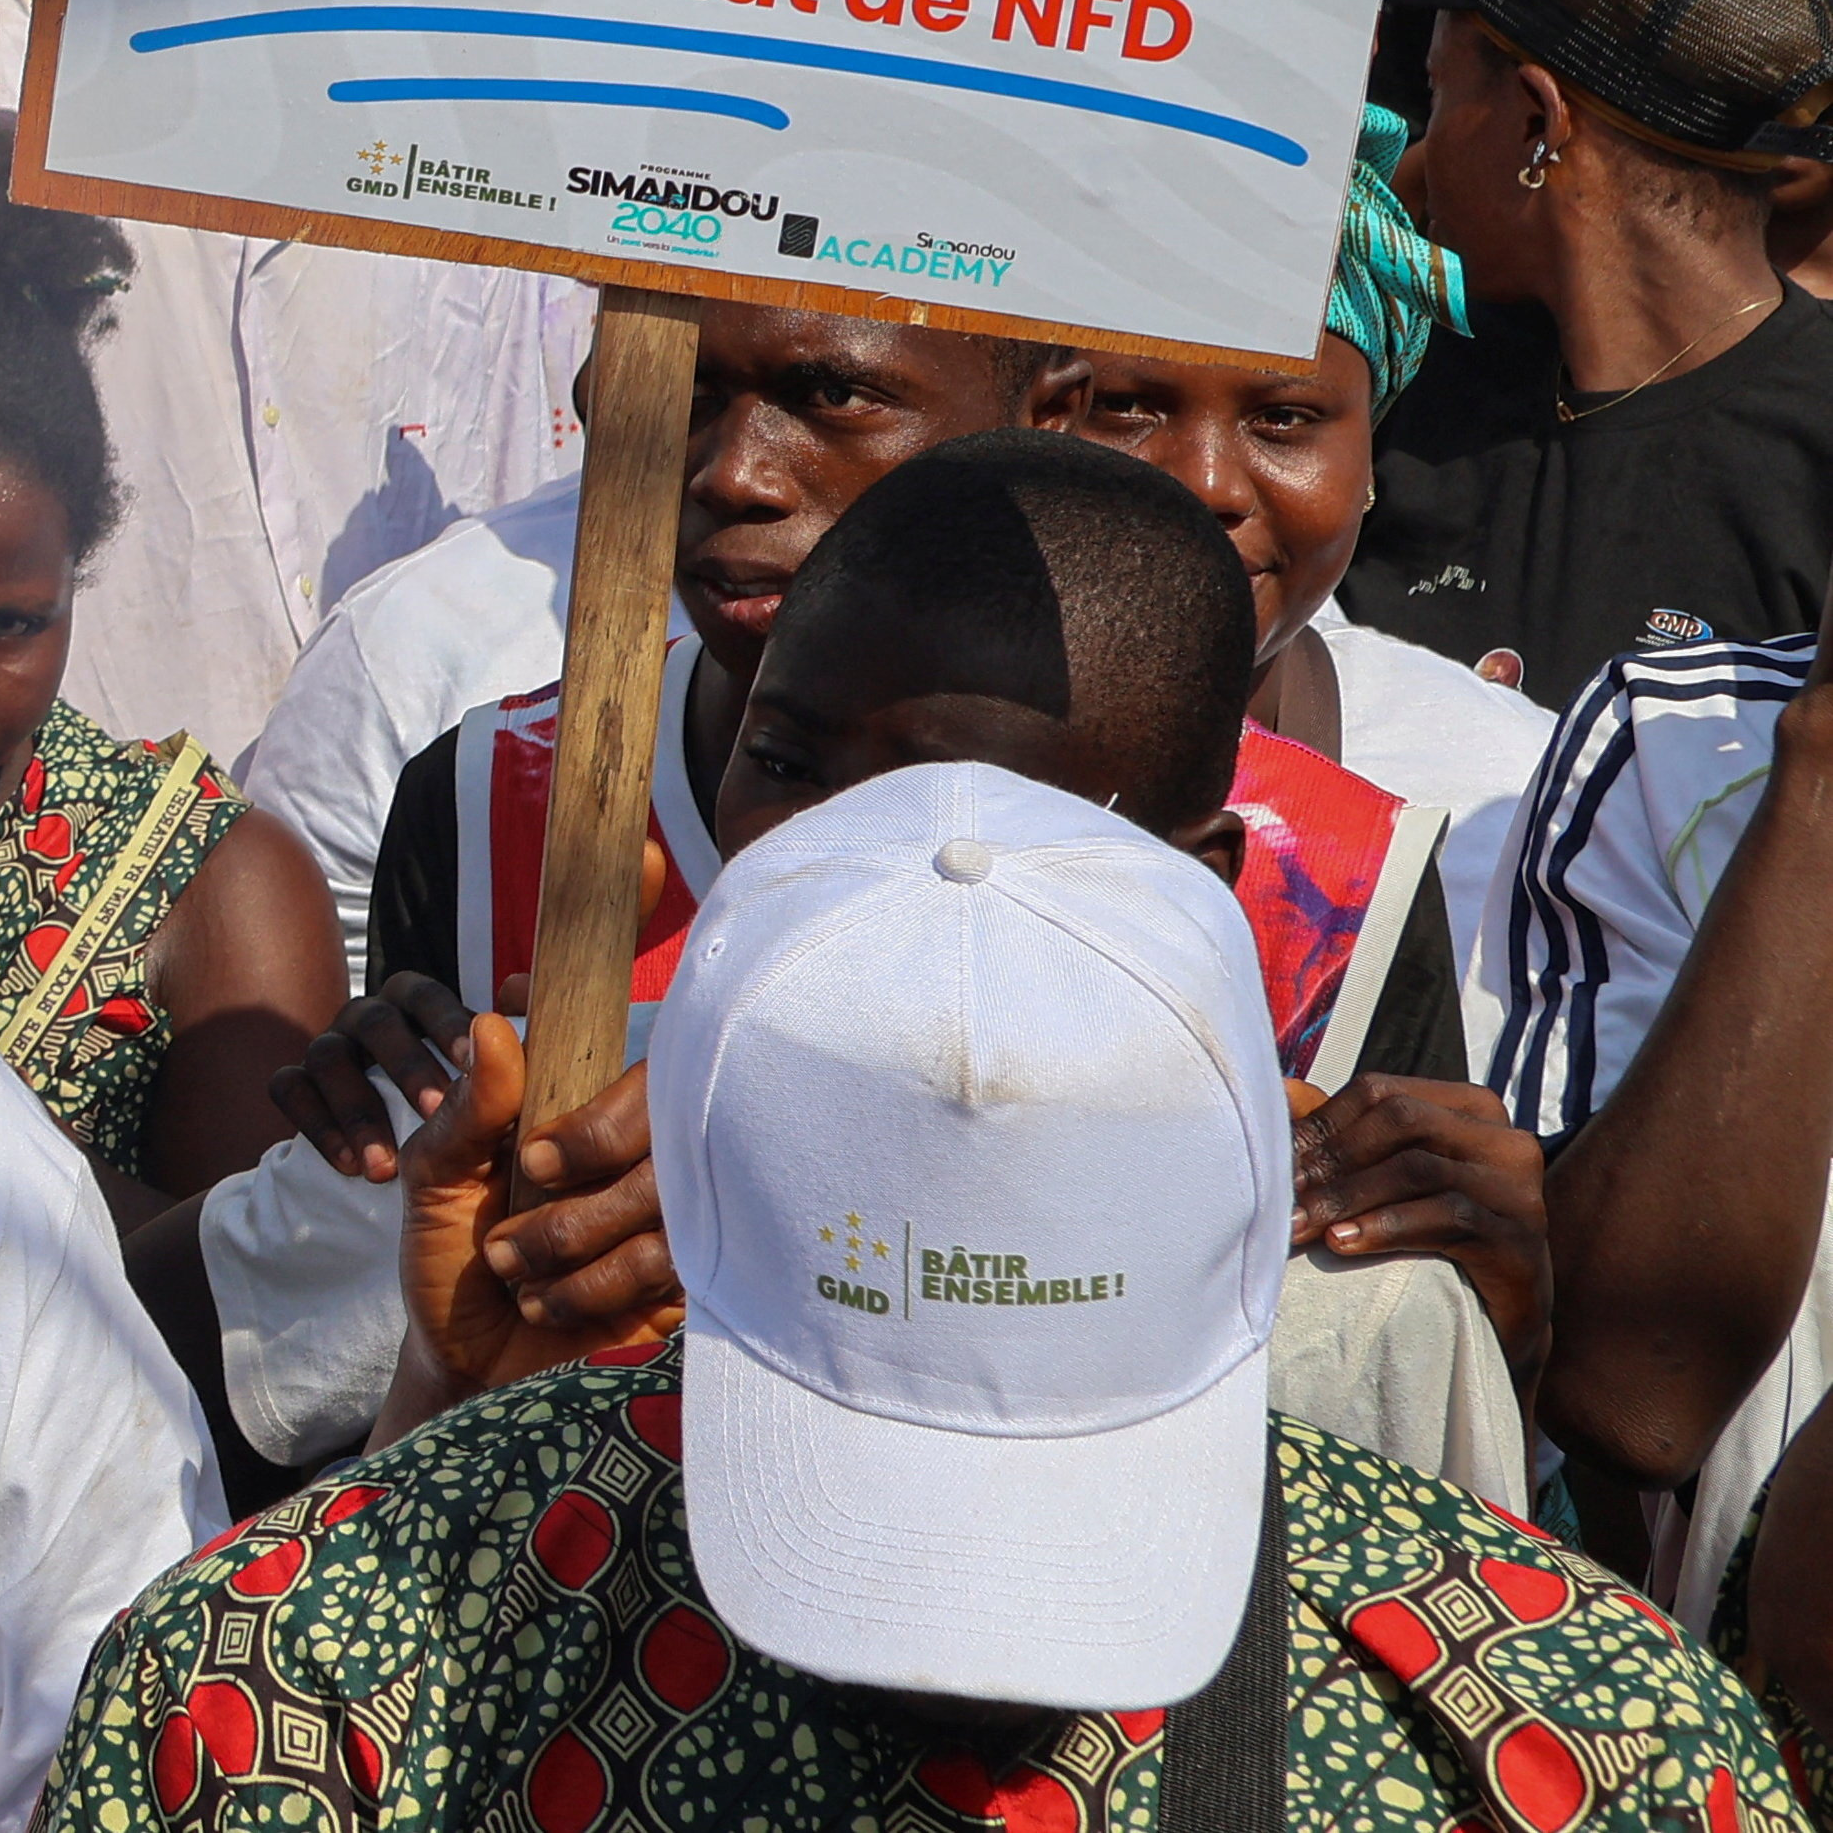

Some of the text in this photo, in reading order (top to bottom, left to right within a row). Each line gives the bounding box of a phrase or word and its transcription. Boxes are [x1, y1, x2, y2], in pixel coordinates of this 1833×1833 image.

[346, 175, 398, 199] GMD
[419, 158, 492, 186] BÂTIR
[639, 163, 713, 181] PROGRAMME
[566, 166, 780, 222] SIMANDOU
[611, 202, 722, 244] 2040
[816, 235, 1013, 288] ACADEMY
[917, 230, 1017, 263] Simandou
[1653, 612, 1703, 640] CMP
[920, 1243, 1029, 1280] BÂTIR
[816, 1273, 891, 1316] GMD
